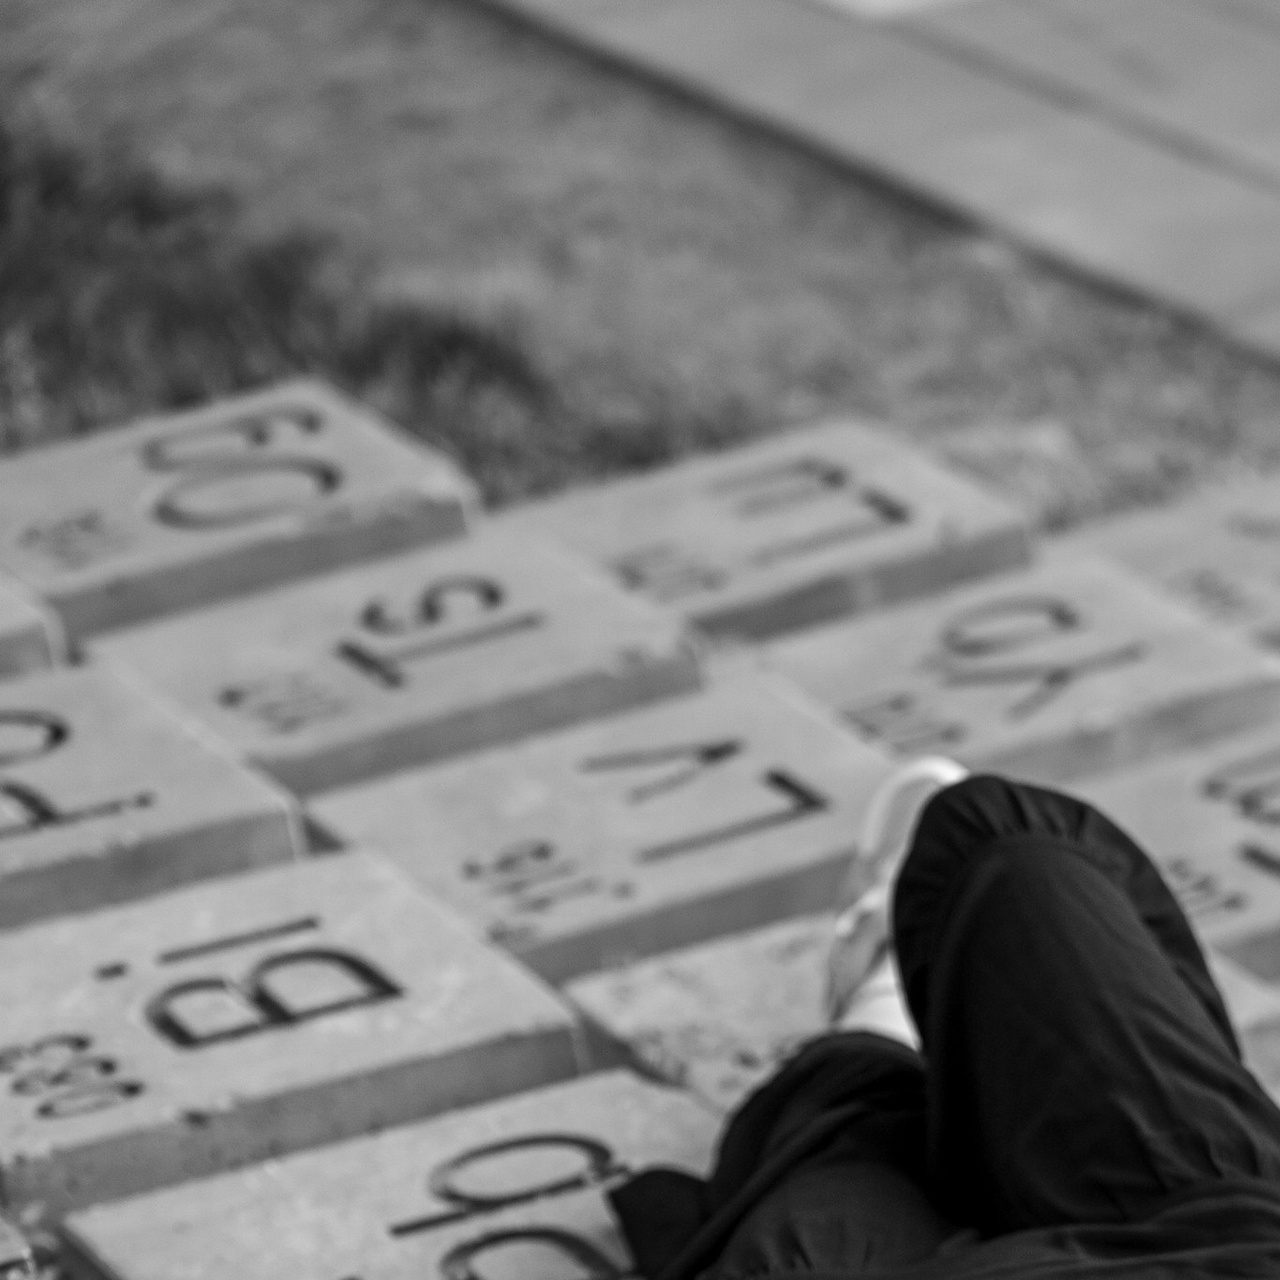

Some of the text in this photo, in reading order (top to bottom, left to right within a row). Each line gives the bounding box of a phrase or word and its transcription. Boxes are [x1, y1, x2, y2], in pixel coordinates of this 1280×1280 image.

[335, 576, 546, 690] Ts
[580, 738, 828, 865] Lv
[95, 917, 405, 1049] Bi
